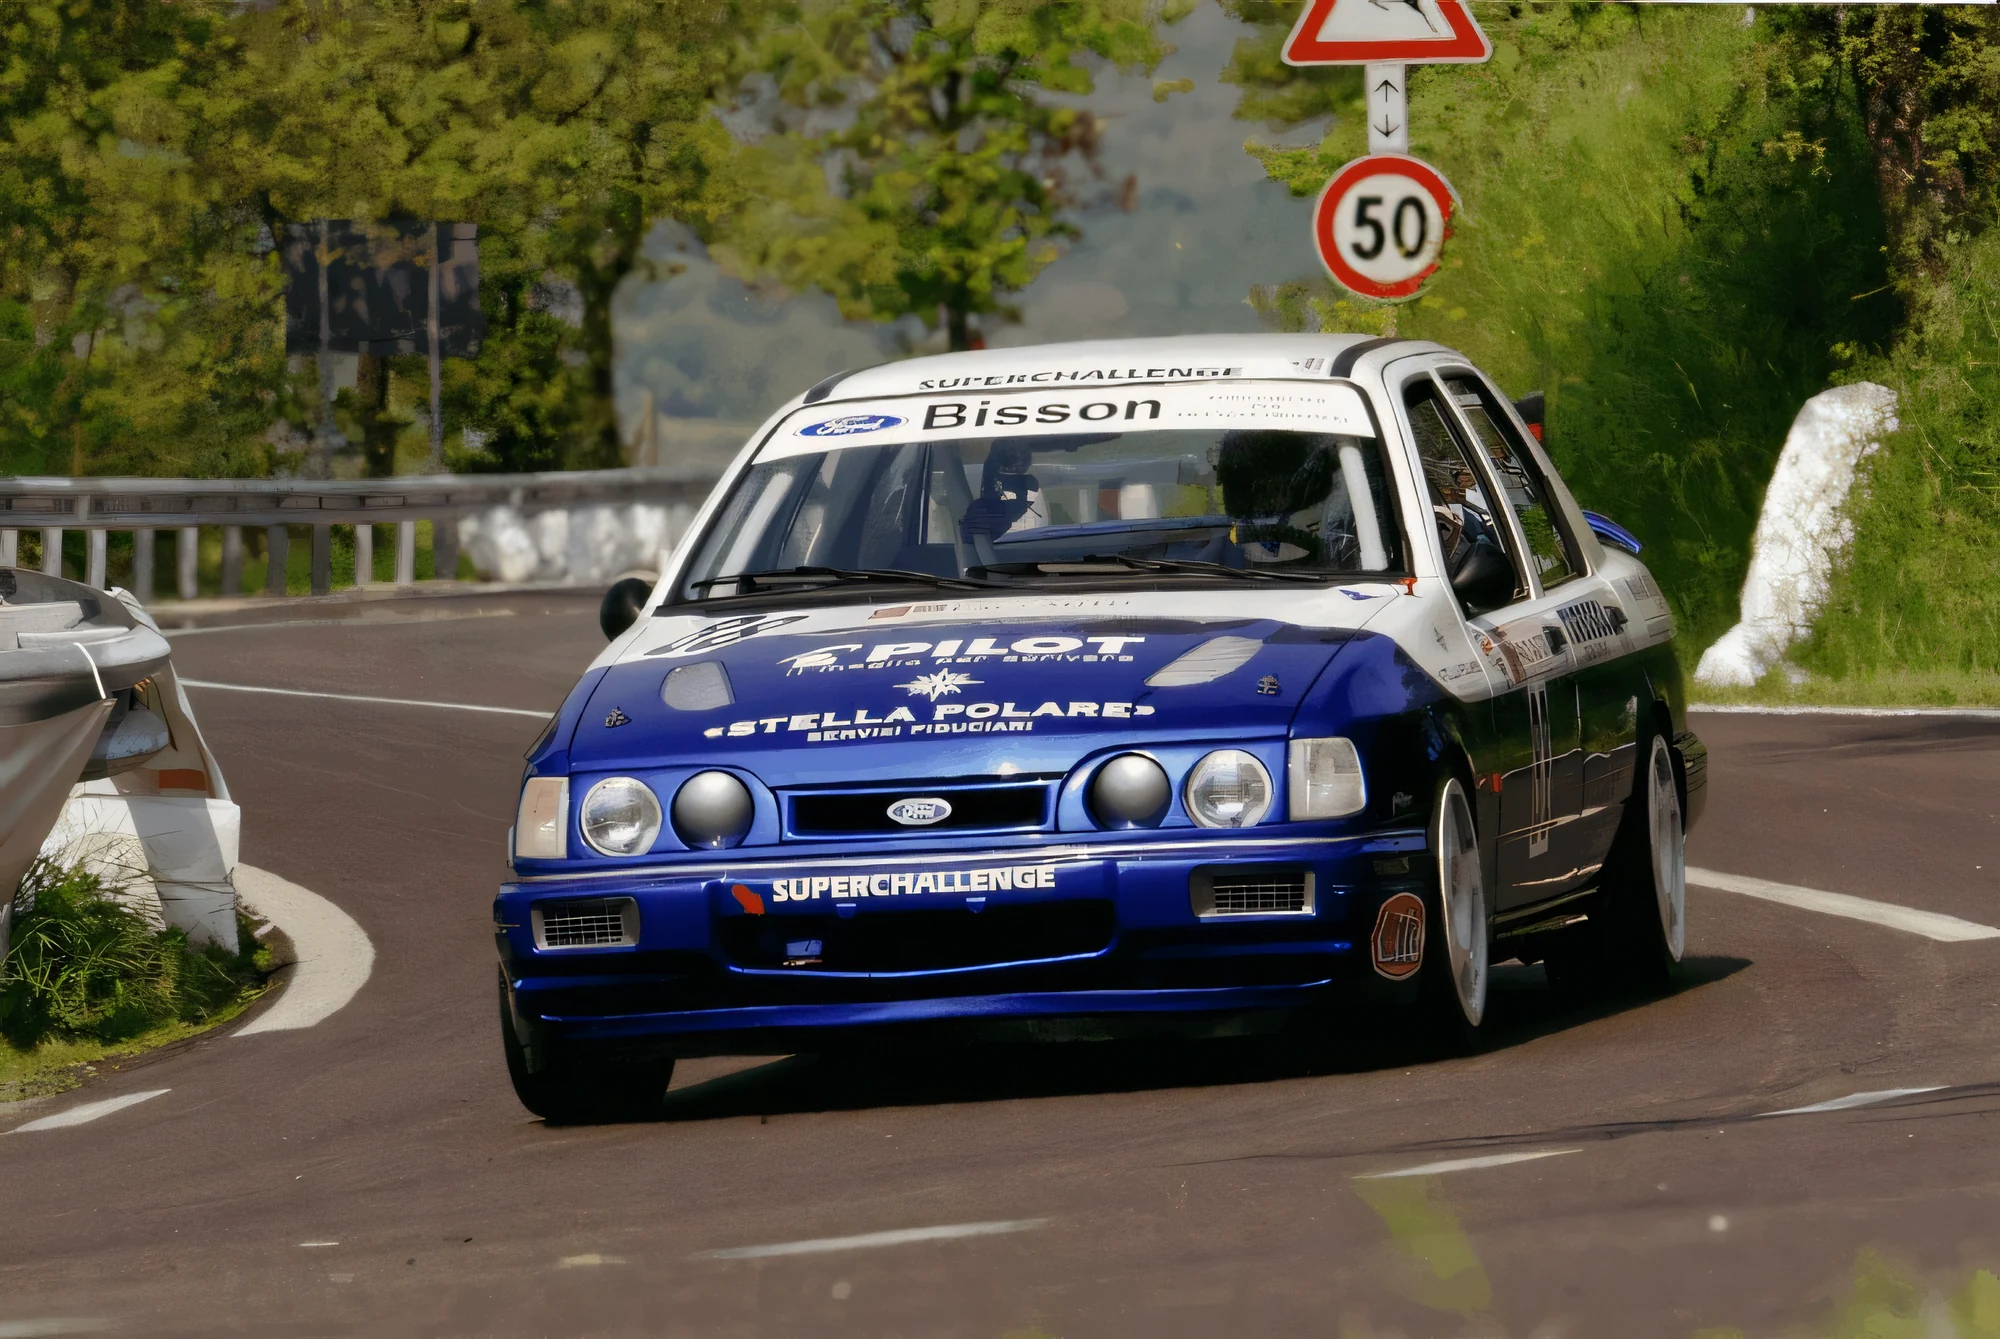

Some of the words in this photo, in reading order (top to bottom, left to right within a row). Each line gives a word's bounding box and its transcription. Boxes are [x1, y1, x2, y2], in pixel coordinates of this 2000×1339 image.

[1352, 195, 1427, 260] 50
[922, 400, 1162, 431] Bisson
[865, 636, 1146, 663] PILOT
[727, 706, 916, 738] STELLA
[932, 702, 1133, 721] POLARE
[772, 866, 1056, 902] SUPERCHALLENGE
